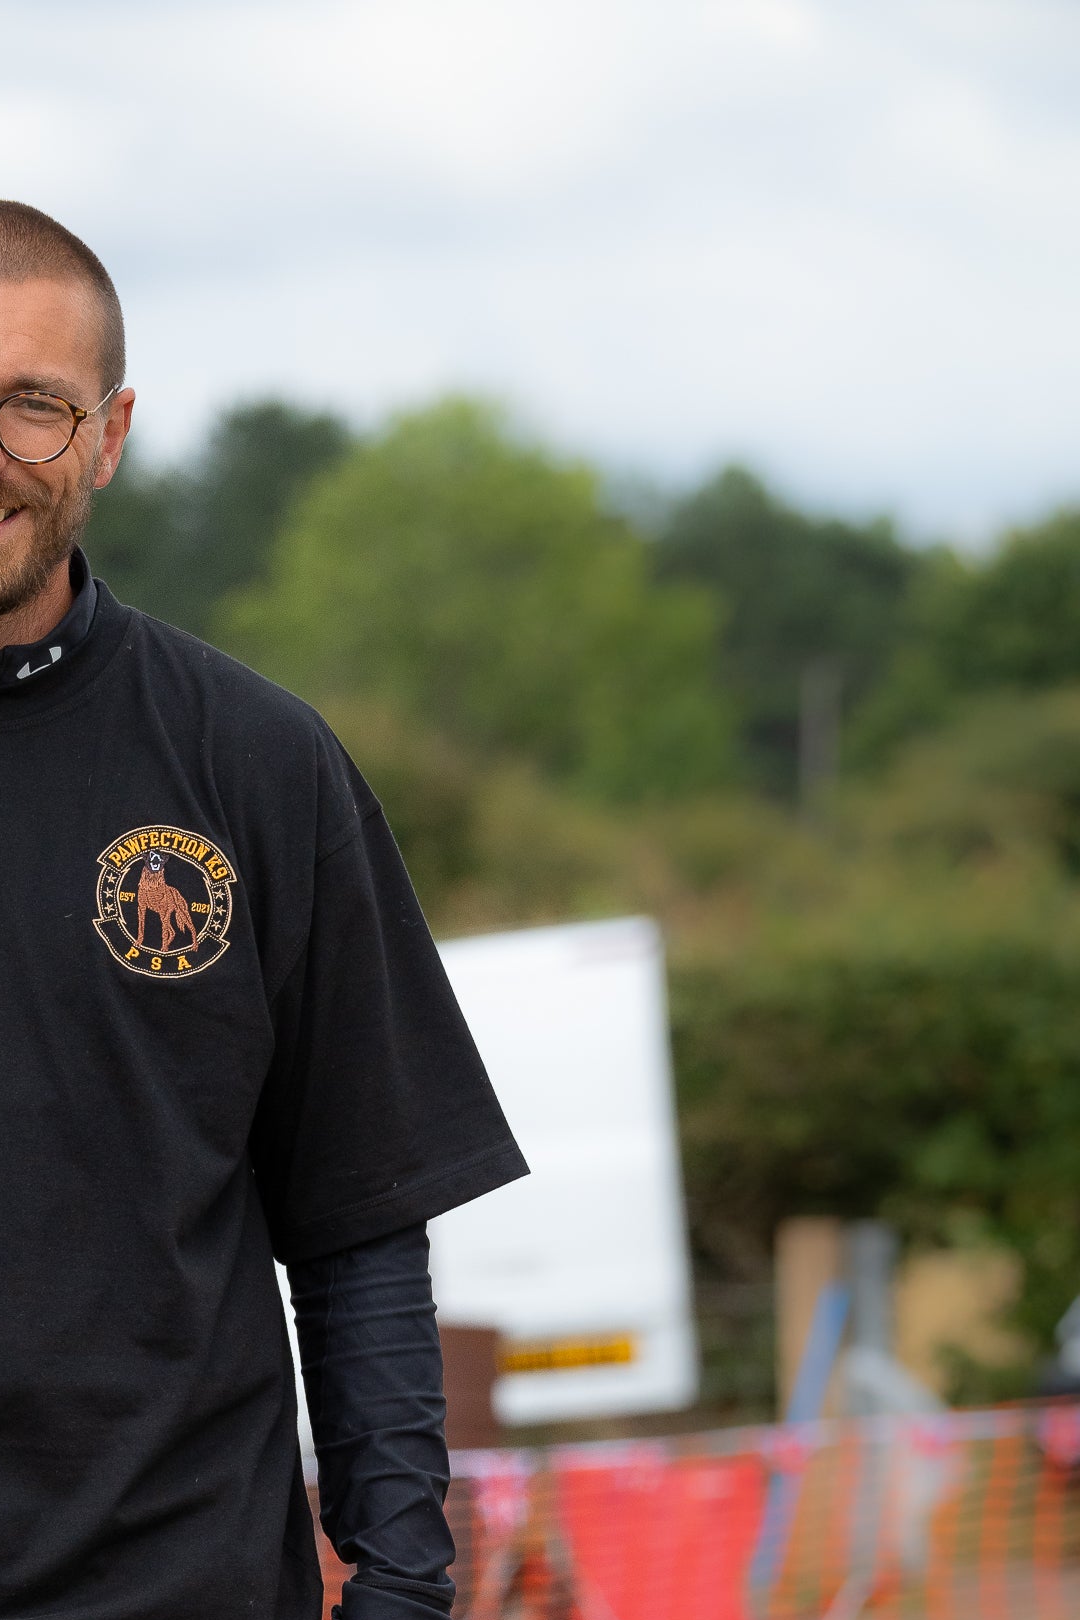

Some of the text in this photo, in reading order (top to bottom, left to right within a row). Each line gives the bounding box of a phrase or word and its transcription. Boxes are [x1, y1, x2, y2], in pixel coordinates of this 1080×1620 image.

[108, 831, 228, 881] PAWFECTION K9
[119, 891, 135, 902] EST
[191, 901, 210, 914] 2021
